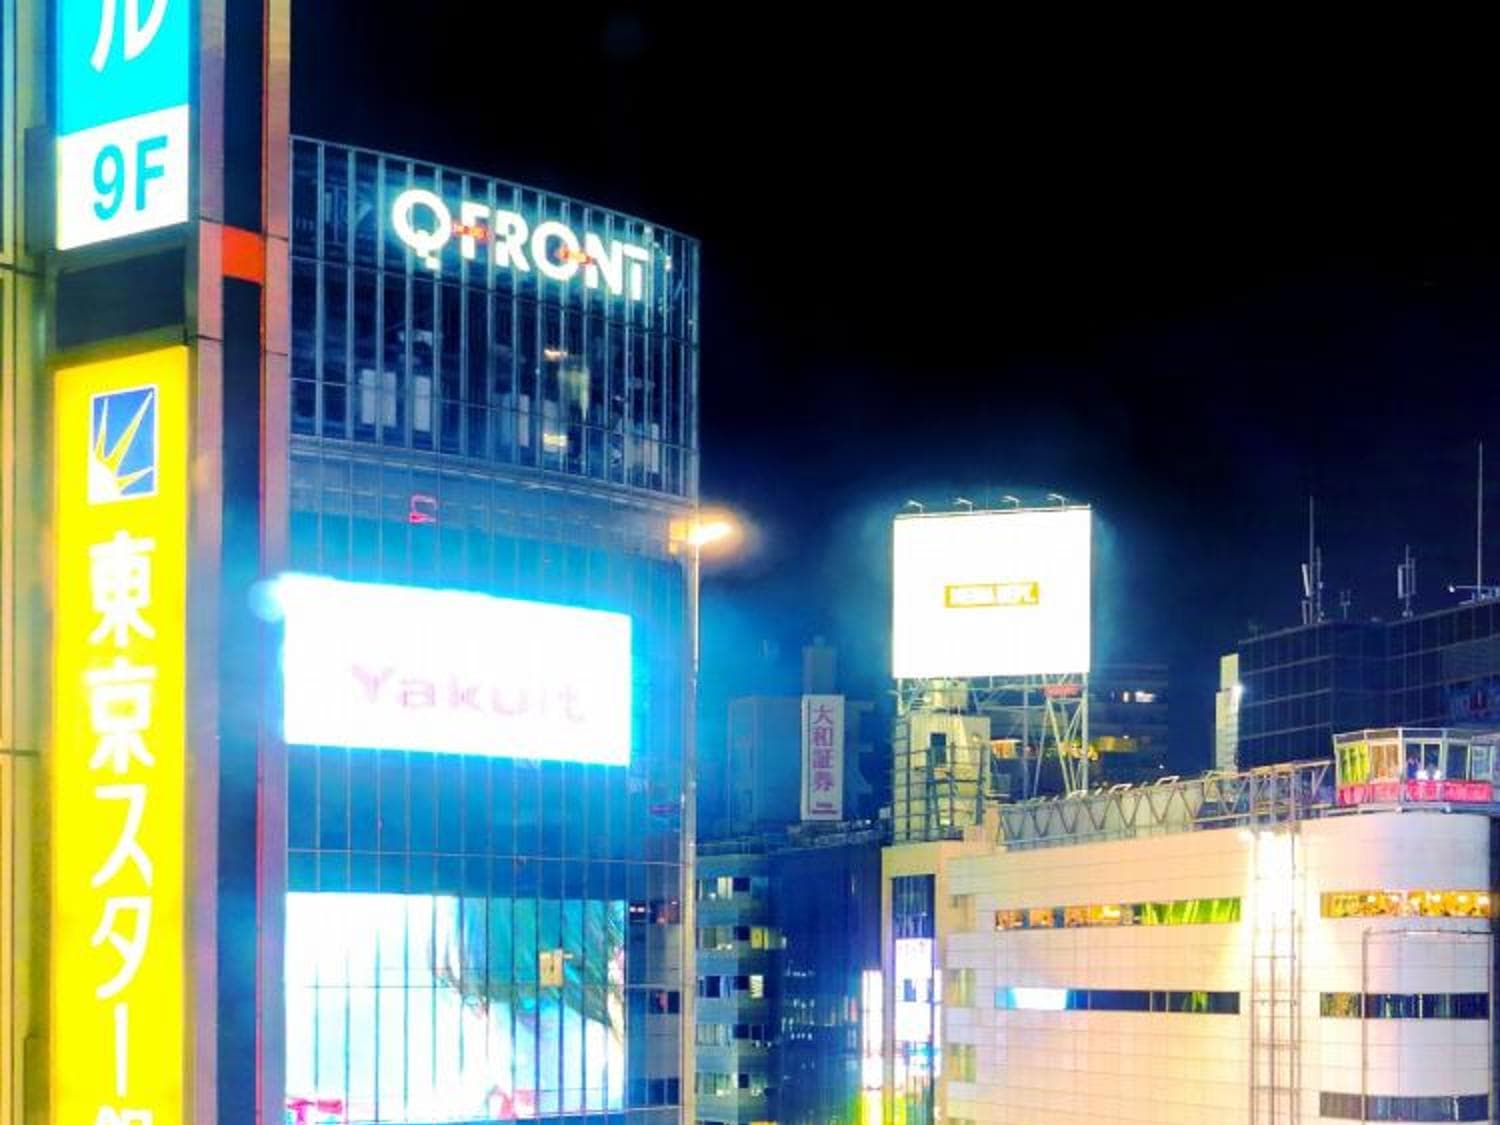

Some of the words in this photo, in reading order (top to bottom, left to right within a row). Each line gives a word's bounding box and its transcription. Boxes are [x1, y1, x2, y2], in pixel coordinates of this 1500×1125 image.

[92, 135, 169, 220] 9F
[392, 188, 649, 301] QFRONT
[350, 663, 586, 723] Yakult
